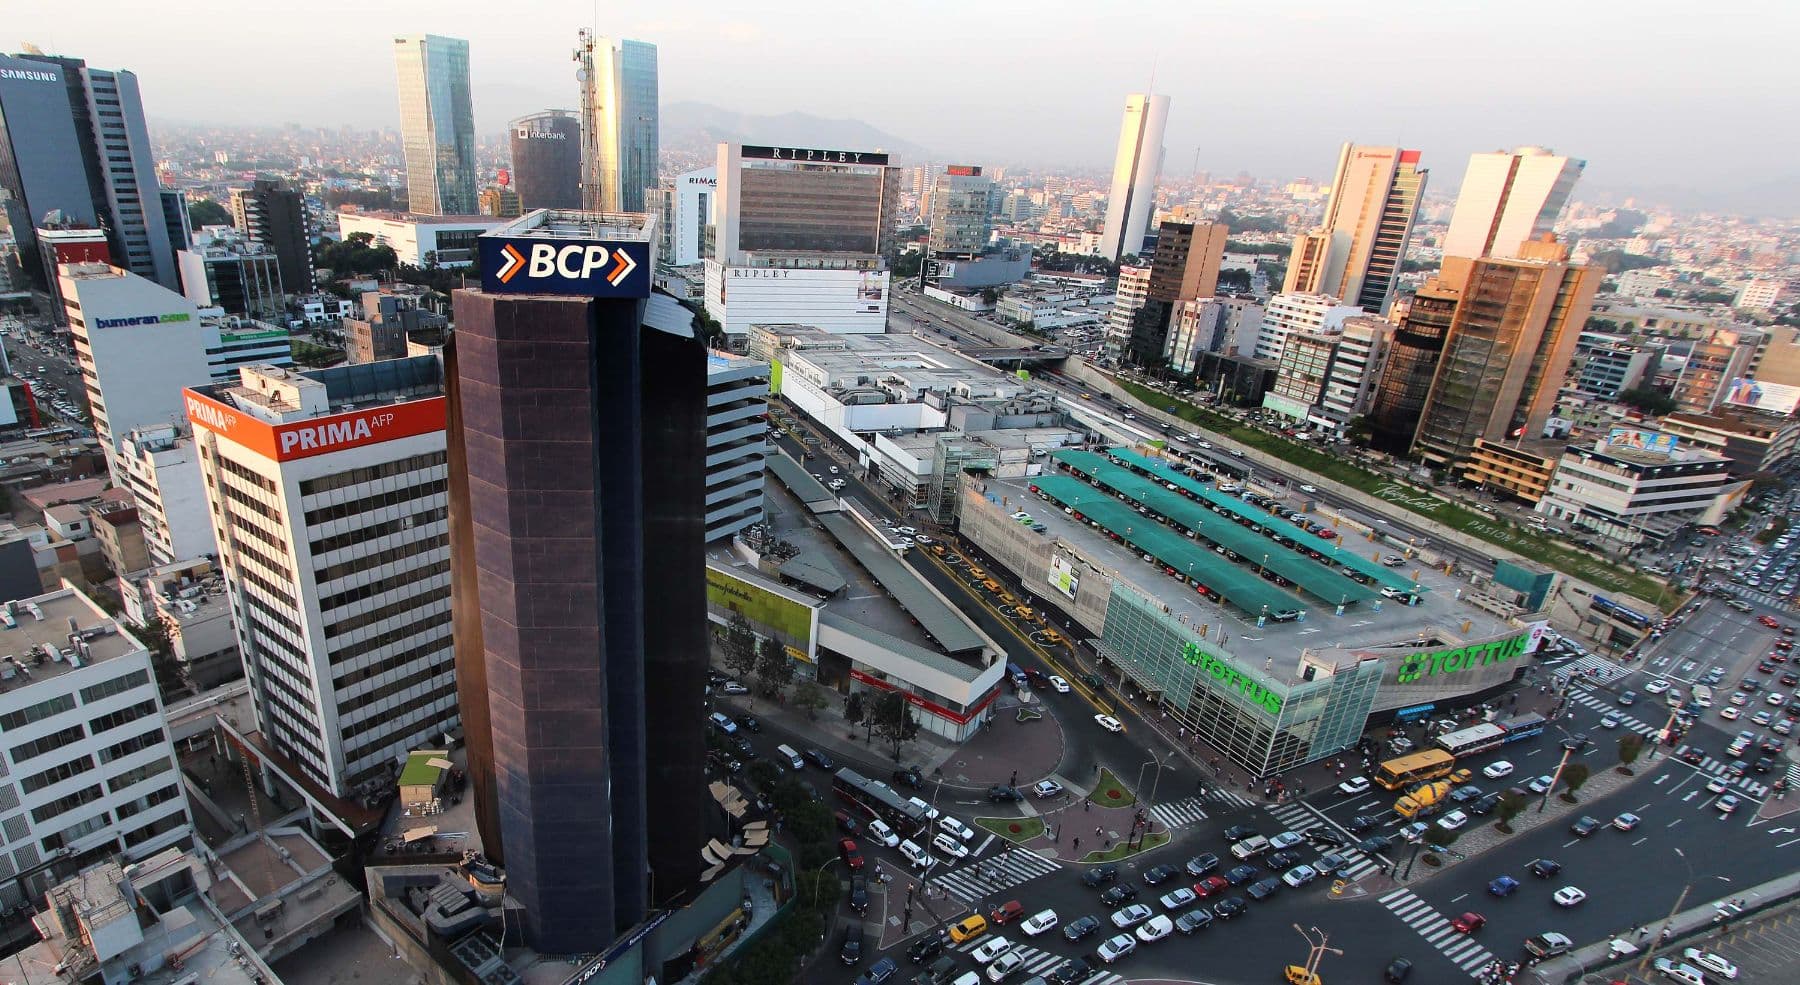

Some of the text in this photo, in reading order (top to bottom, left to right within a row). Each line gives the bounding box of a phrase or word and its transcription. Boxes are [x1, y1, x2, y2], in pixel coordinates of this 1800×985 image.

[0, 69, 57, 81] SAMSUNG
[773, 147, 862, 163] RIPLEY
[528, 243, 609, 279] BCP
[734, 269, 789, 278] RIPLEY
[95, 313, 190, 329] bumeran.com
[186, 396, 227, 432] PRIMA
[280, 413, 394, 454] PRIMA AFP
[1430, 632, 1530, 677] TOTTUS
[1199, 652, 1281, 714] TOTTUS
[584, 962, 601, 981] BCP
